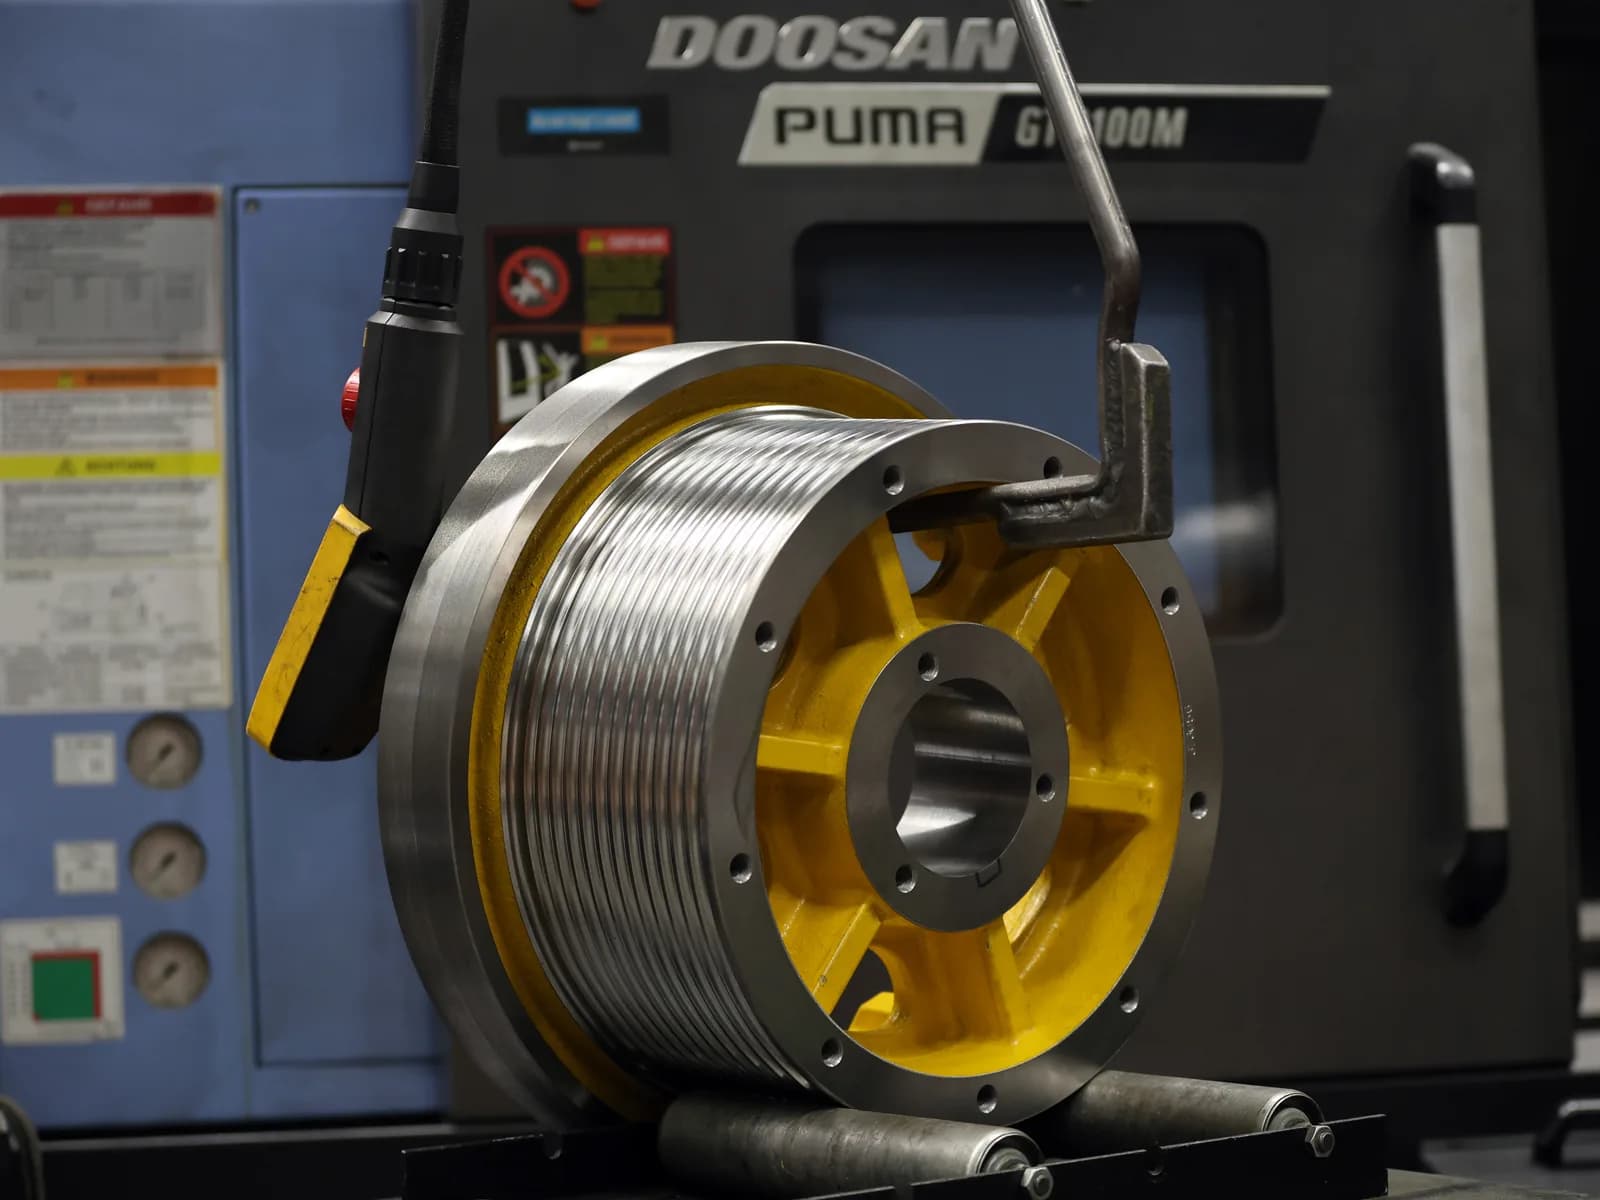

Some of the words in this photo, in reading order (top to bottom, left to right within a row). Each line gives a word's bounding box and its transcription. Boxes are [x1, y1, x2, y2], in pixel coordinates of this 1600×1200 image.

[647, 15, 1020, 71] DOOSAN
[774, 106, 966, 146] PUMA
[1015, 105, 1188, 148] GT100M
